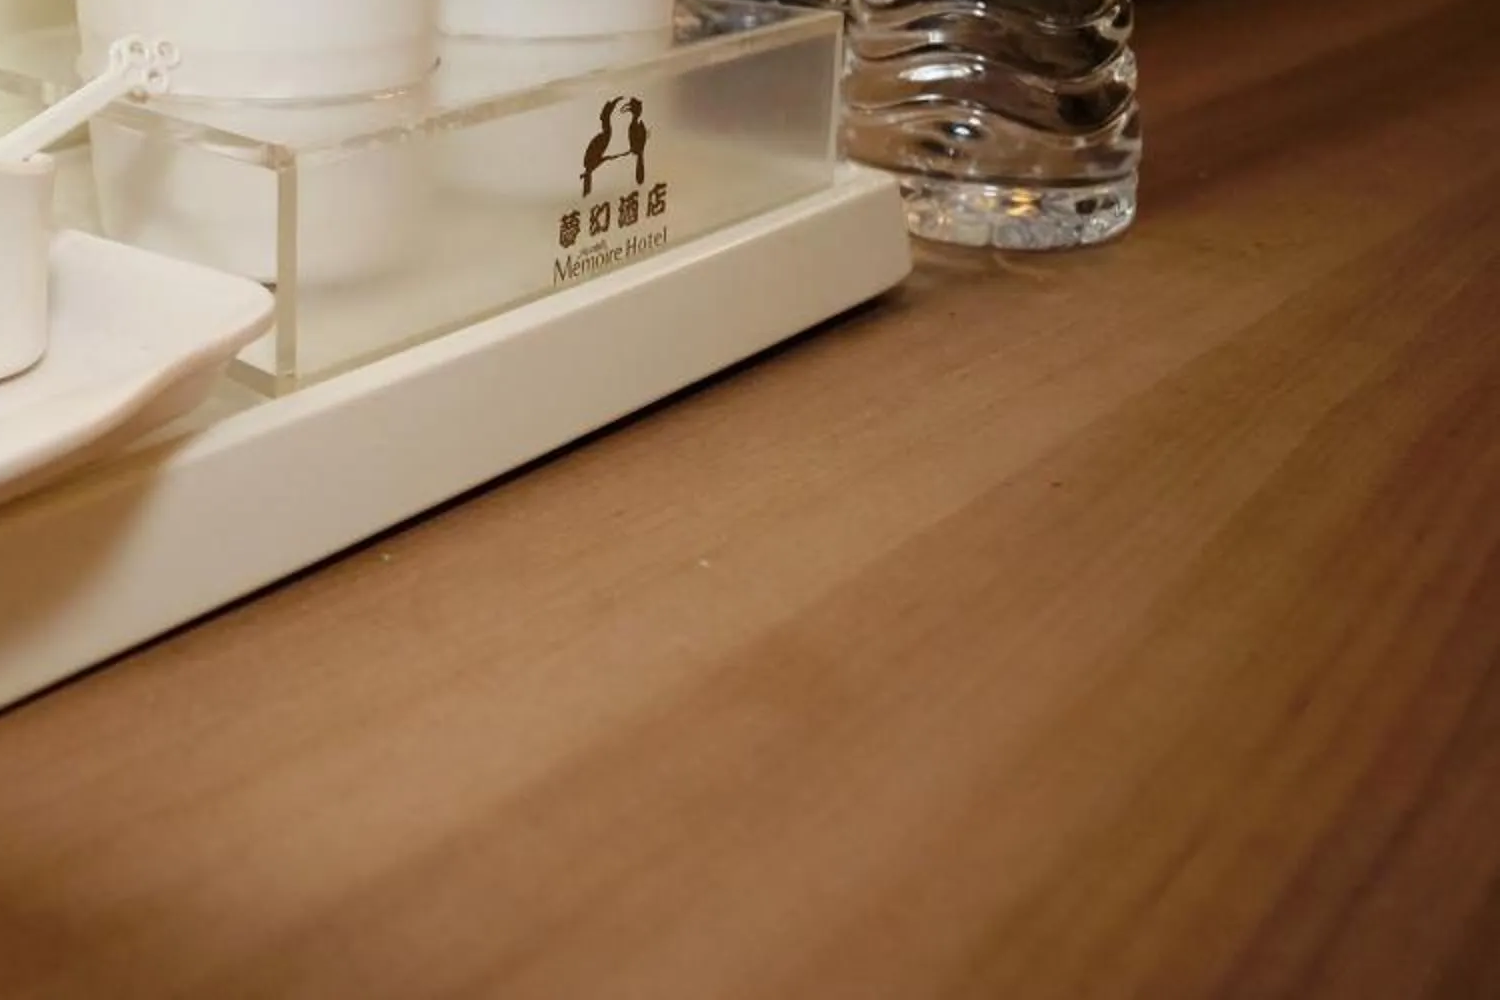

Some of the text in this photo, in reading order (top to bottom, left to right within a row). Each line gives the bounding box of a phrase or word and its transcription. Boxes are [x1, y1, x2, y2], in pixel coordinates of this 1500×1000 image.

[559, 182, 668, 248] 夢幻酒店
[625, 225, 668, 257] Hotel
